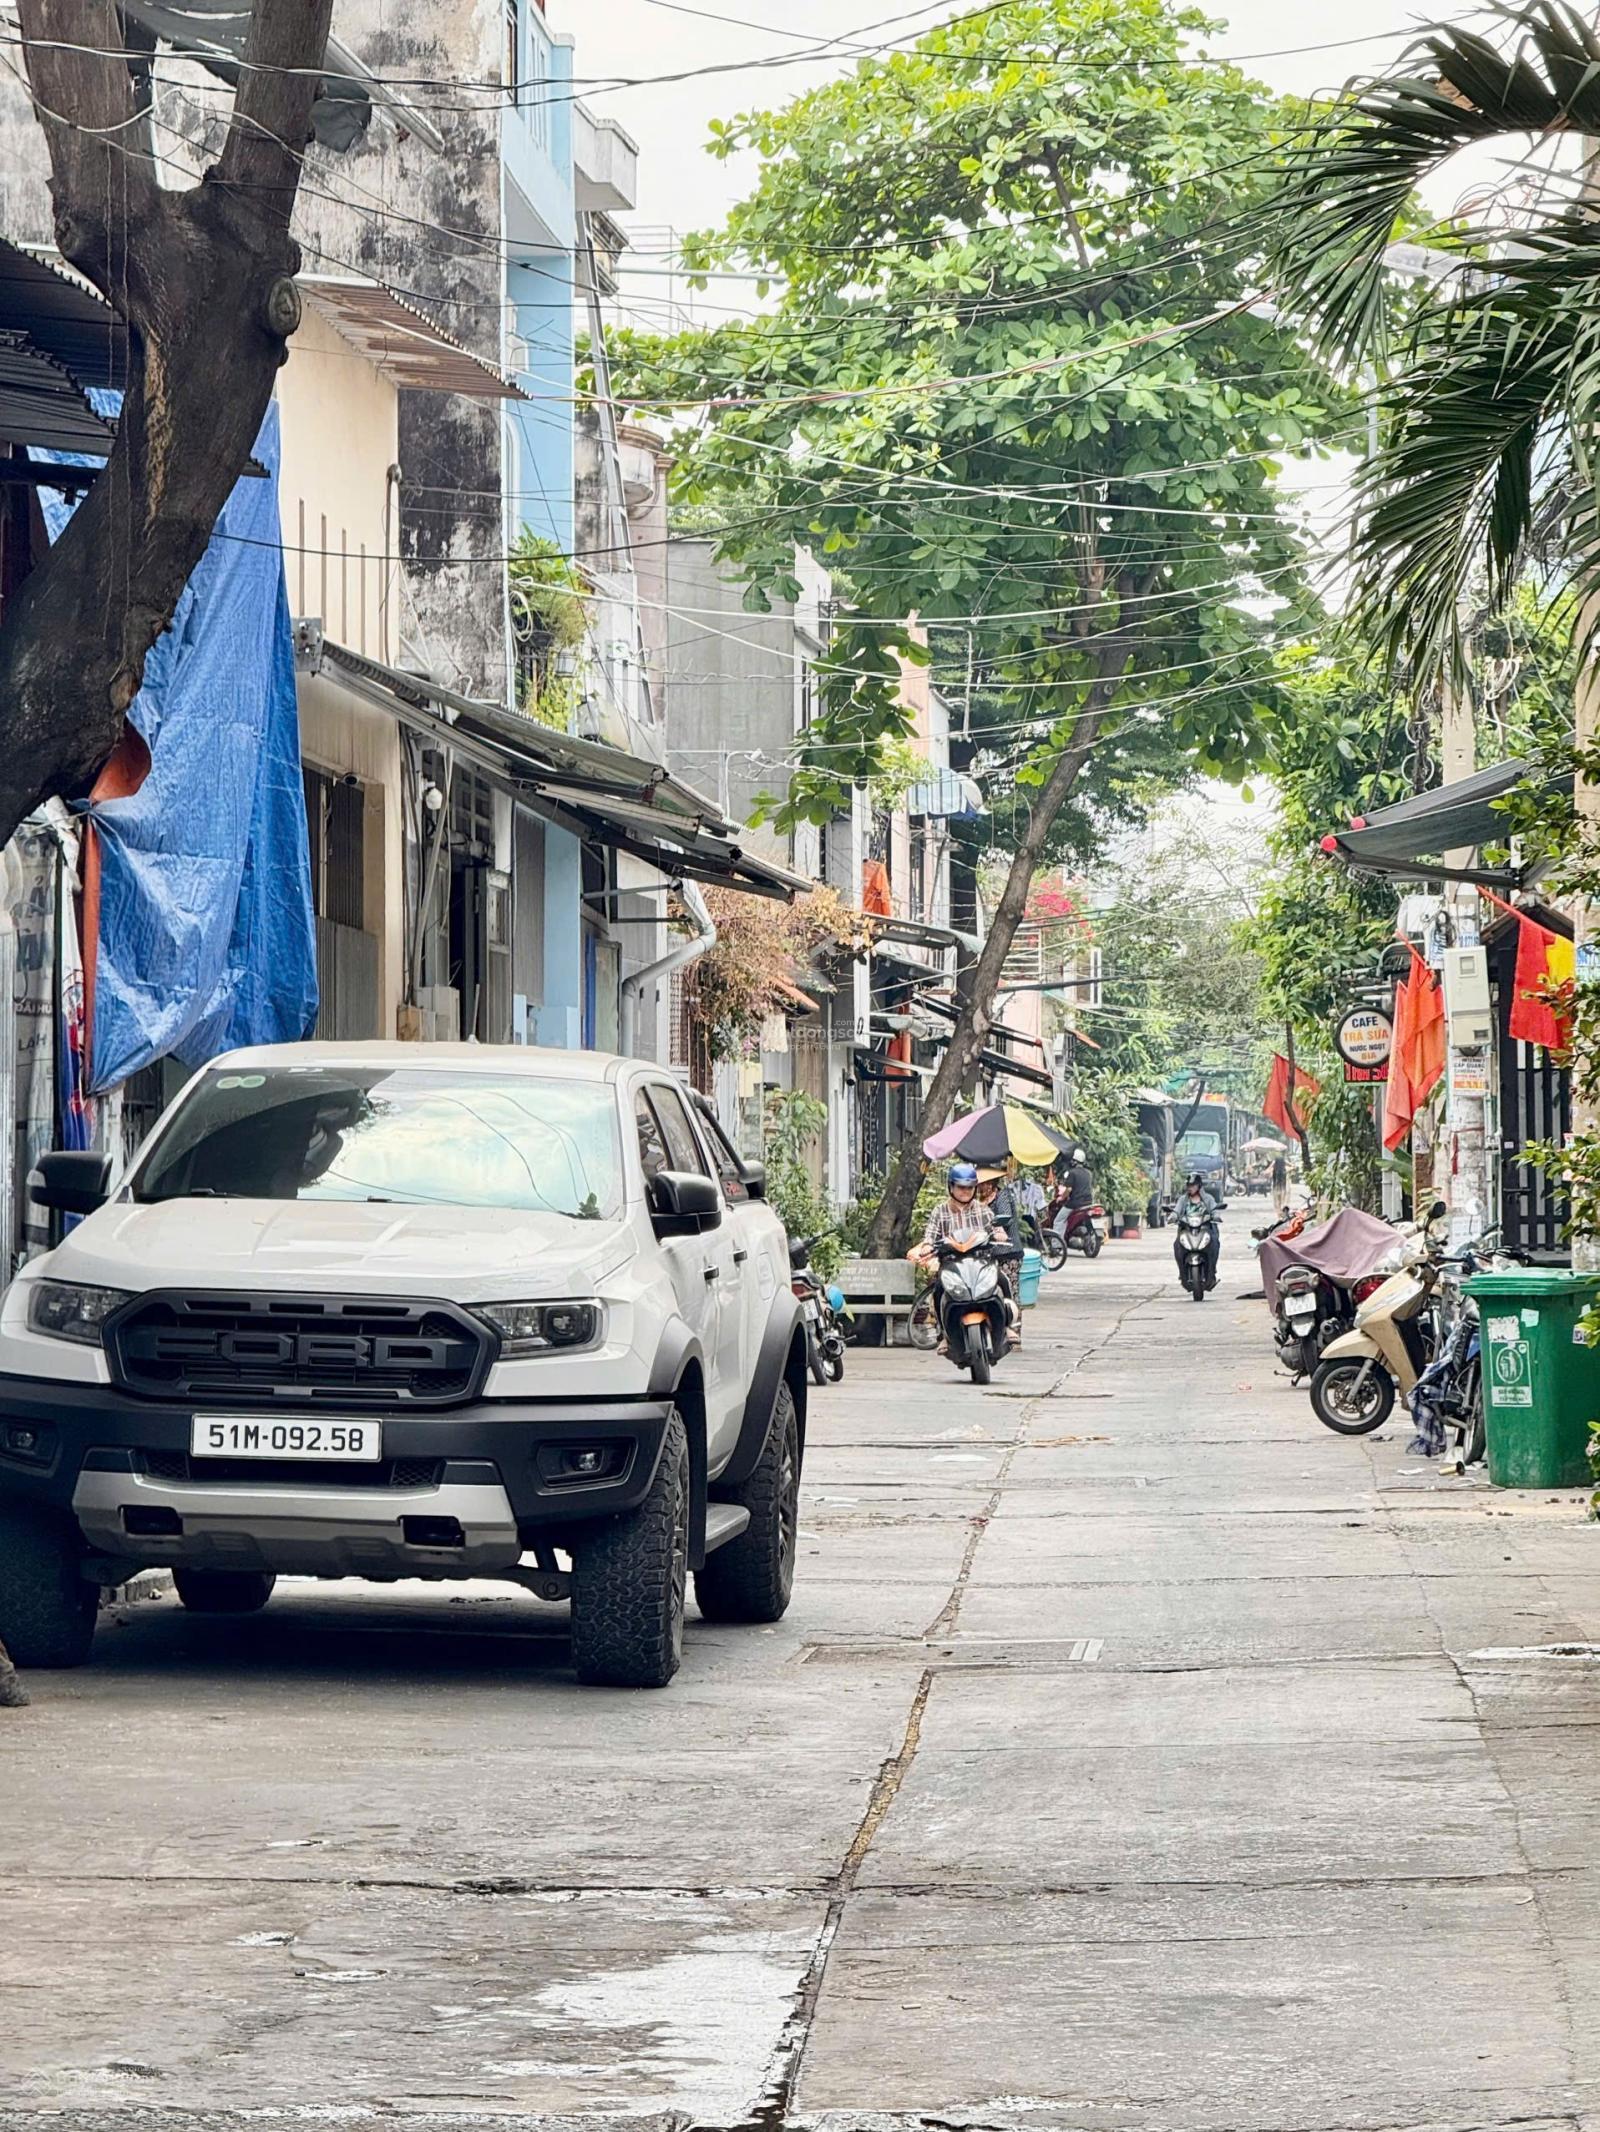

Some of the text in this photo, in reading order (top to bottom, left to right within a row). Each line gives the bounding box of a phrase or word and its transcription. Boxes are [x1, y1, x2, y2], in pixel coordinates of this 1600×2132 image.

[1352, 1016, 1378, 1028] CAFE
[132, 1325, 448, 1369] FORD
[209, 1424, 364, 1452] 51M-092.58
